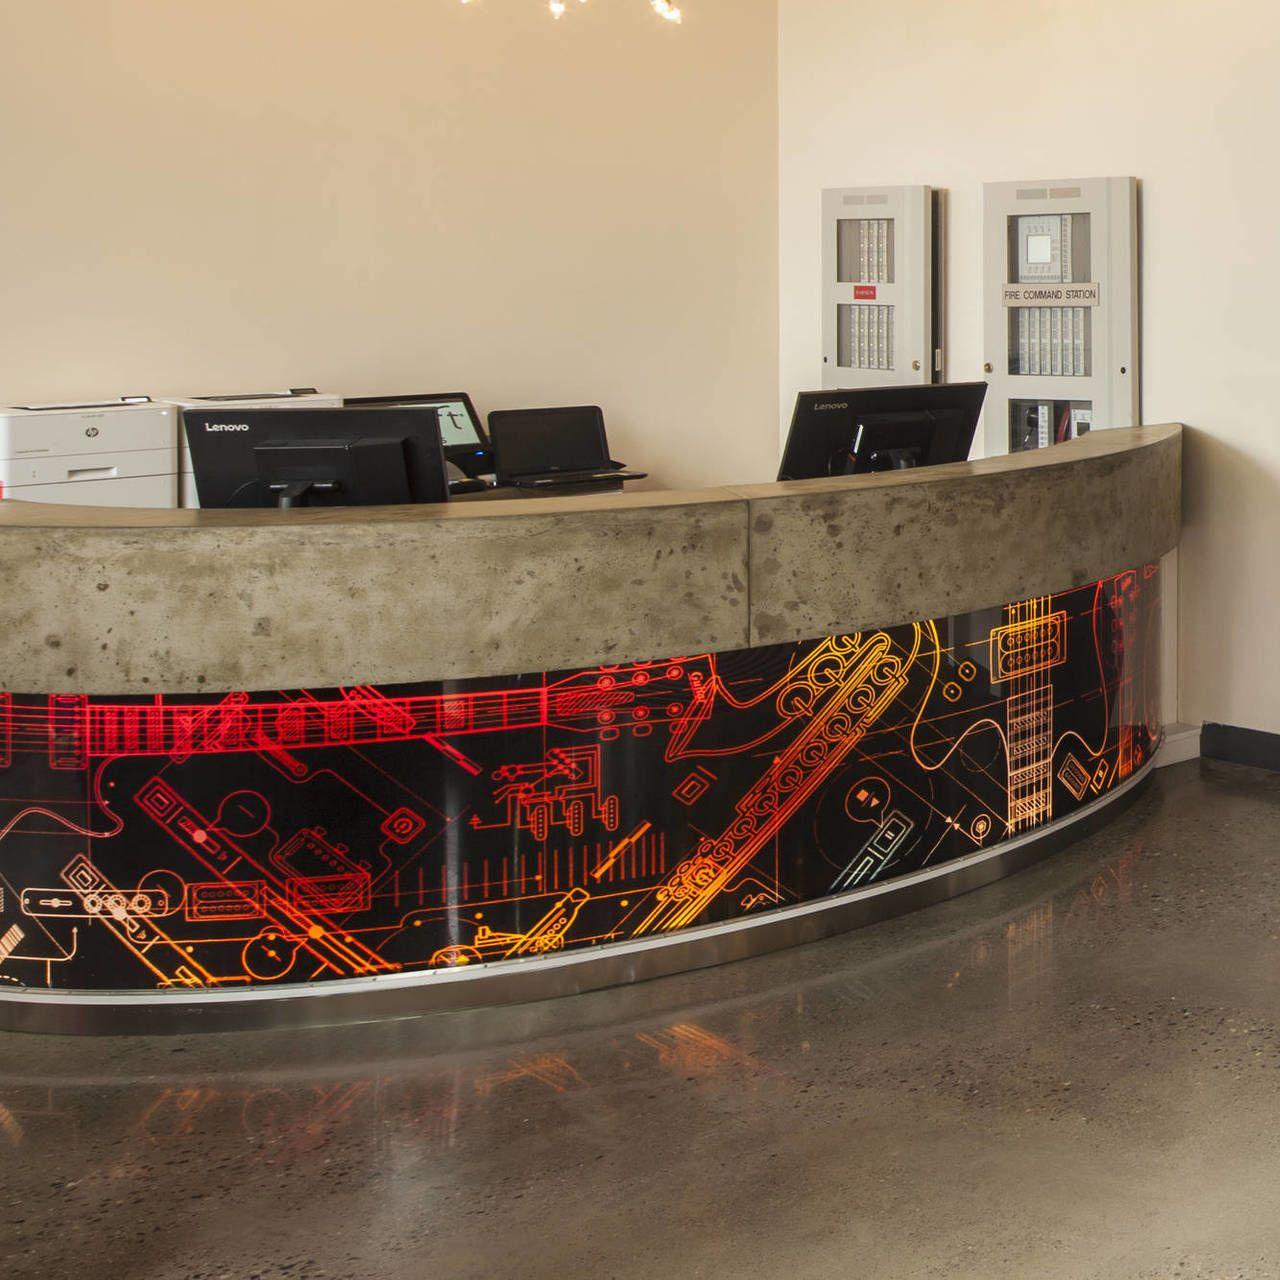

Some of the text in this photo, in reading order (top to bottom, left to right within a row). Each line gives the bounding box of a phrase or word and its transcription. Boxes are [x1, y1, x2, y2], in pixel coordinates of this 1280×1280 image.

[1004, 289, 1096, 300] FIRE COMMAND STATION
[814, 402, 848, 411] Lenovo
[205, 422, 250, 433] Lenovo
